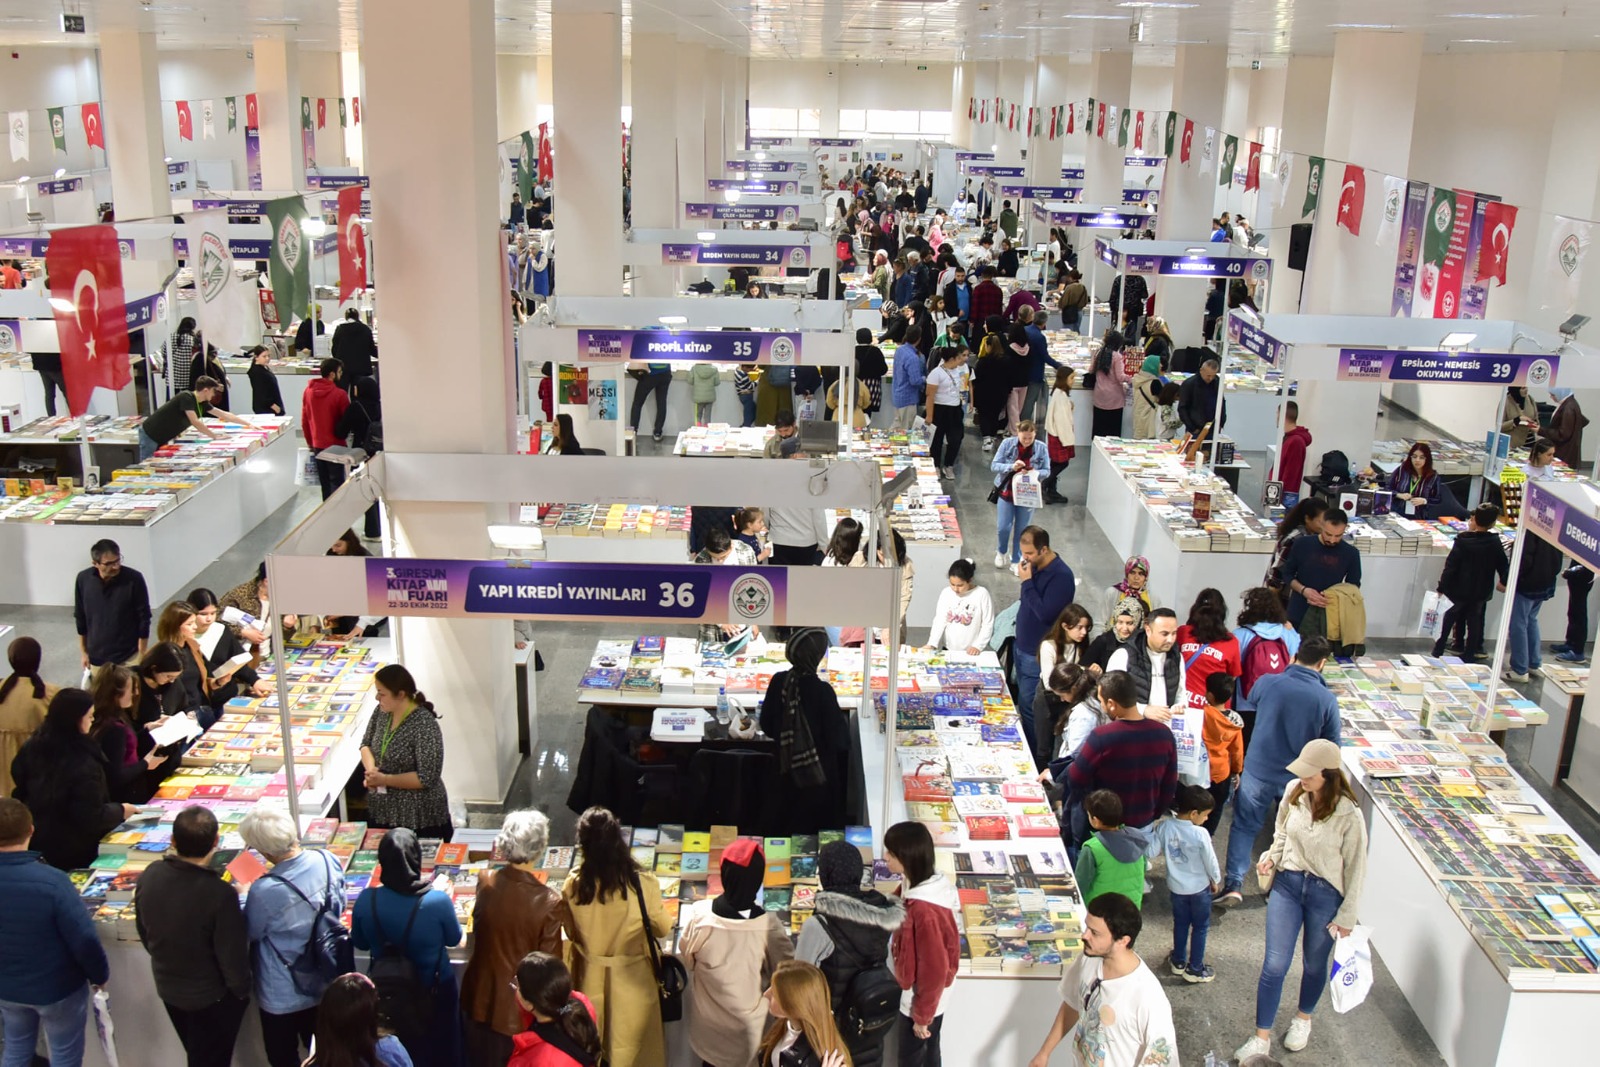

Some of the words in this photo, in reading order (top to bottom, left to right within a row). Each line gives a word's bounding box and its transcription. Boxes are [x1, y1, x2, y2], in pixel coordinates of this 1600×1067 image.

[764, 209, 775, 218] 33
[1128, 218, 1138, 226] 41
[765, 250, 779, 261] 34
[1226, 262, 1241, 273] 40
[141, 305, 150, 320] 21
[648, 340, 683, 353] PROFİL
[684, 341, 712, 353] KİTAP
[733, 341, 752, 356] 35
[1402, 358, 1437, 369] EPSİLON
[1444, 360, 1481, 370] NEMESİS
[1491, 363, 1511, 378] 39
[559, 372, 588, 380] RONALDO
[1416, 370, 1451, 379] OKUYAN
[1452, 371, 1463, 379] US
[588, 388, 617, 397] MESSI
[1565, 522, 1598, 552] DERGAH
[387, 578, 427, 590] KİTAP
[408, 591, 448, 602] FUARI
[479, 583, 513, 599] YAPI
[517, 582, 563, 600] KREDİ
[566, 584, 646, 602] YAYINLARI
[659, 581, 695, 608] 36
